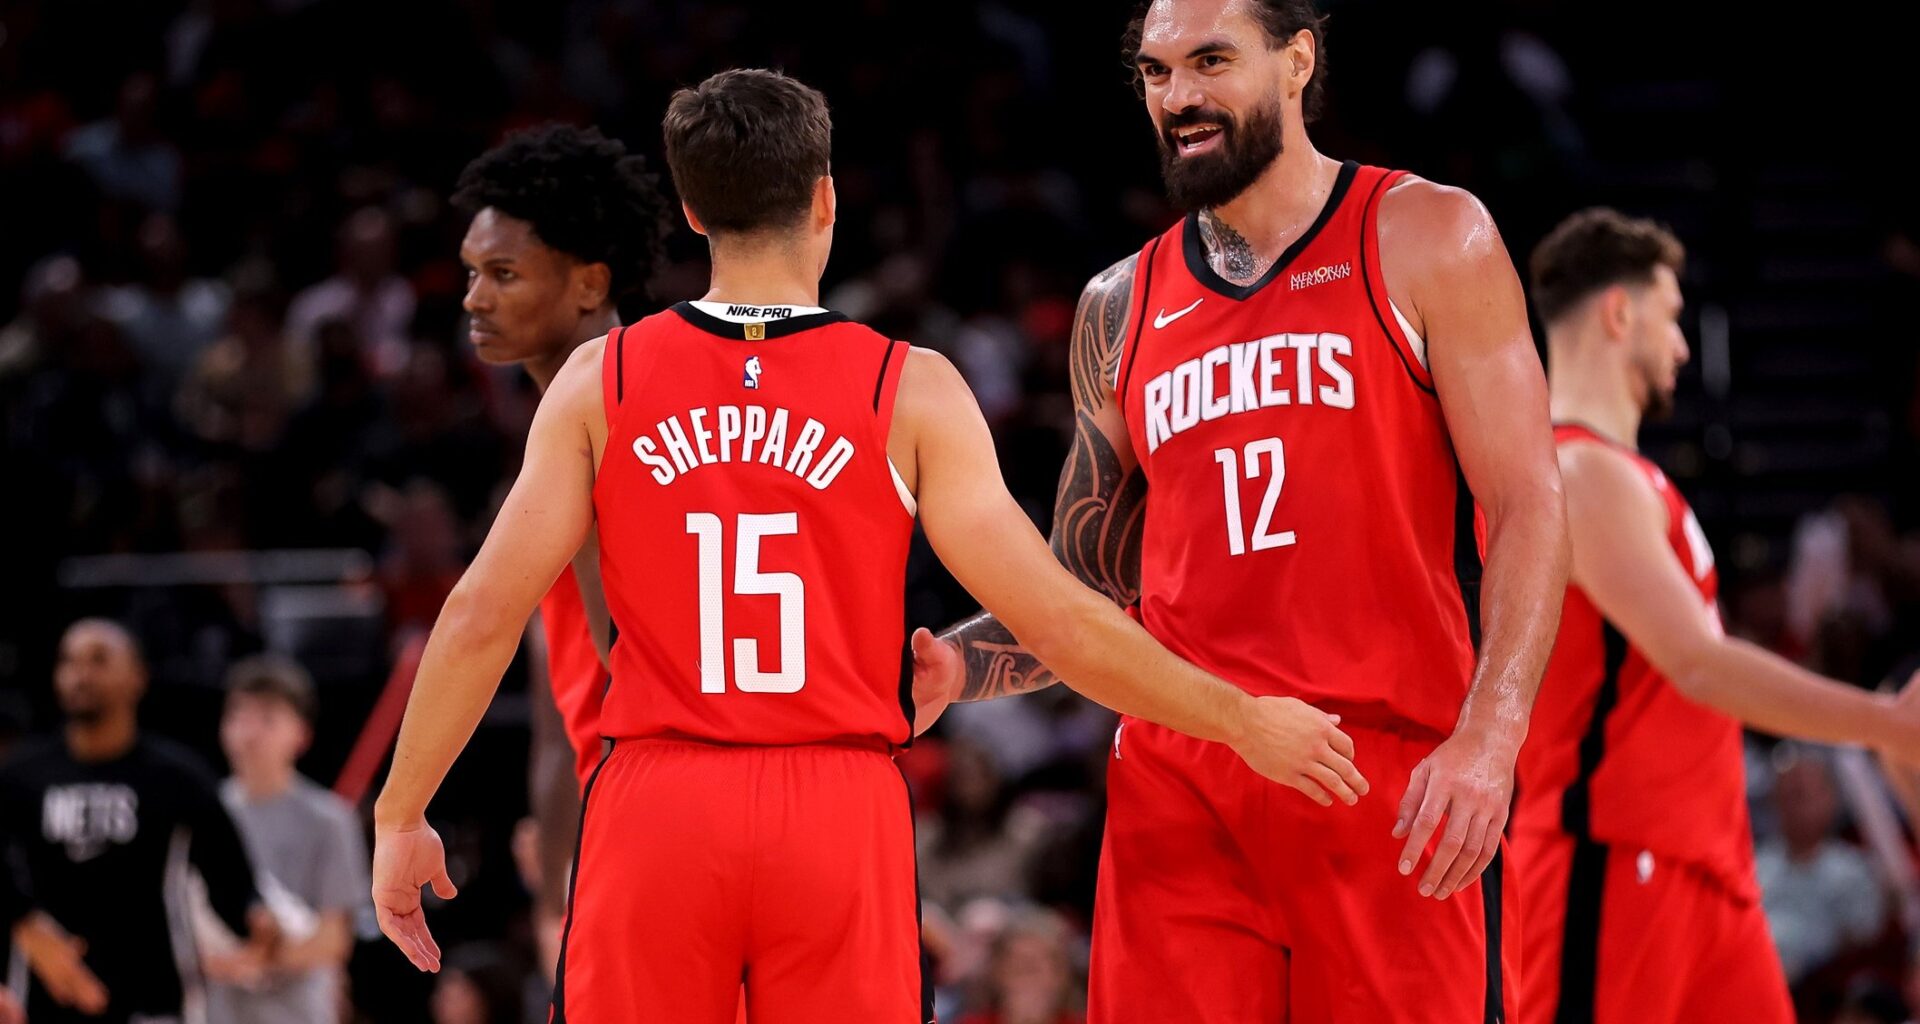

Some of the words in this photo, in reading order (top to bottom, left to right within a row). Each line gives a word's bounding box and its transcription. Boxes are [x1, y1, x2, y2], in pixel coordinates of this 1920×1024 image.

[1290, 262, 1351, 282] MEMORIAL
[1291, 269, 1350, 291] HERMANN
[726, 305, 761, 317] NIKE
[761, 308, 792, 319] PRO
[1144, 332, 1356, 456] ROCKETS
[632, 405, 855, 490] SHEPPARD
[1214, 437, 1297, 556] 12
[685, 512, 806, 694] 15
[42, 782, 138, 844] NETS
